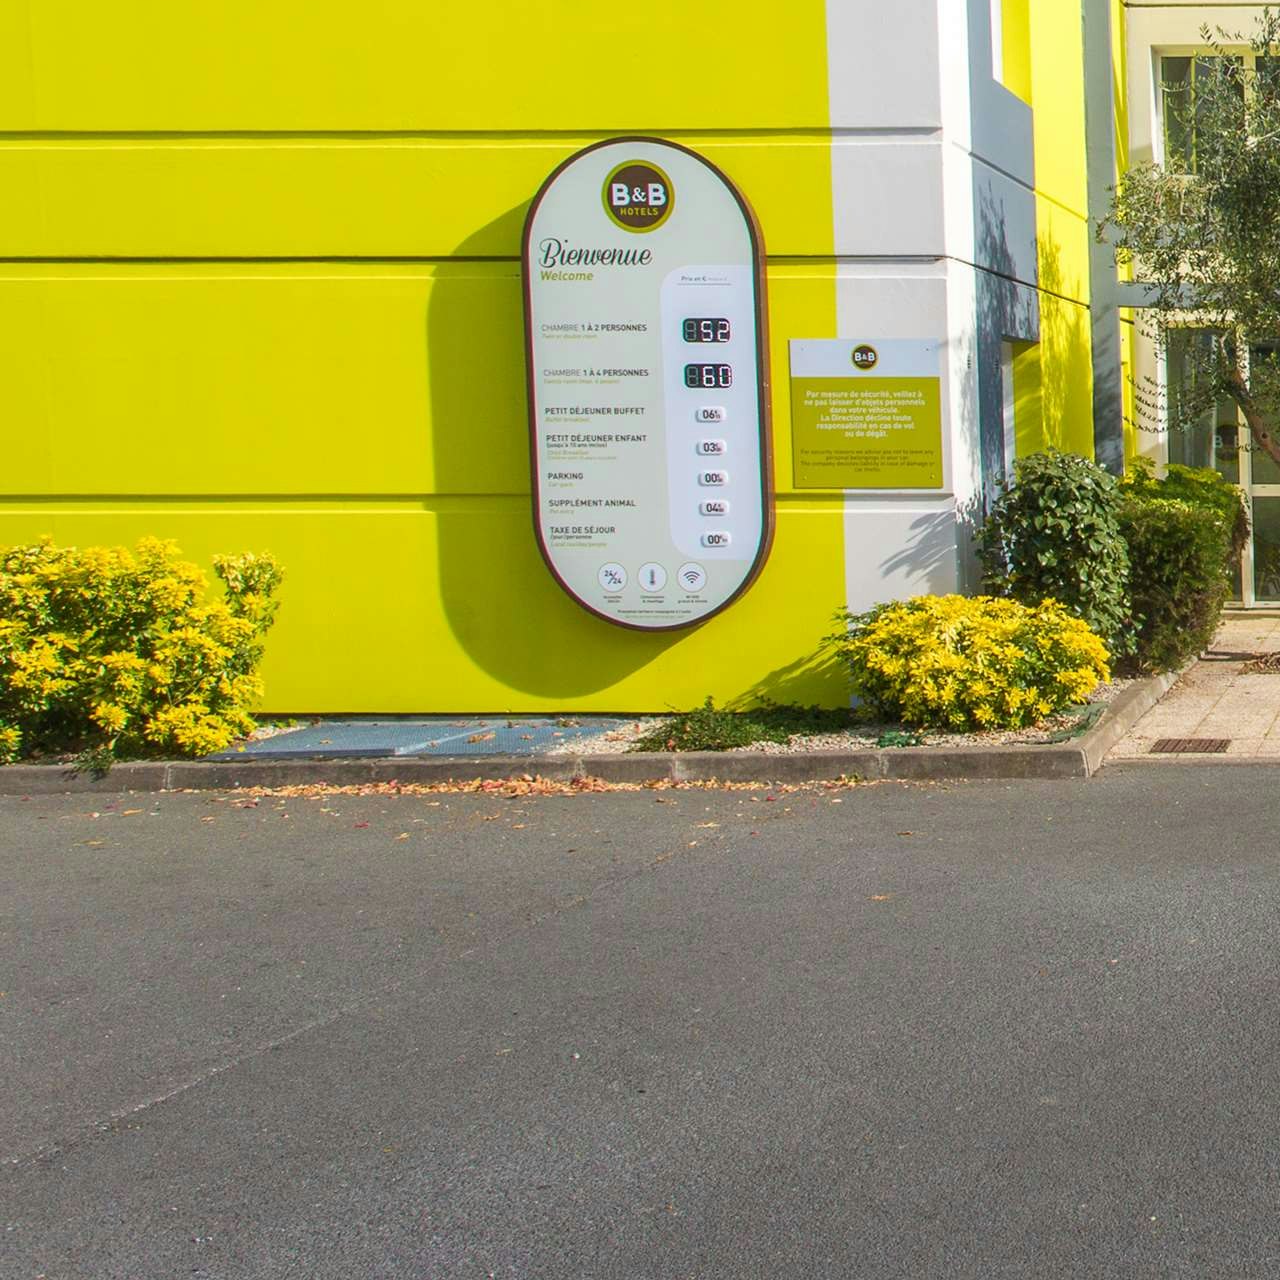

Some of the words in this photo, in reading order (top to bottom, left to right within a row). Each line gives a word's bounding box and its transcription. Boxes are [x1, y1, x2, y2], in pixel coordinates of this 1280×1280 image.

[611, 183, 667, 206] B&B
[620, 207, 659, 216] HOTELS
[539, 237, 653, 269] Bienvenue
[541, 270, 594, 281] Welcome
[541, 324, 578, 332] CHAMBRE
[581, 324, 586, 332] 1
[594, 324, 600, 332] 2
[601, 324, 648, 332] PERSONNES
[700, 320, 730, 342] 52
[543, 369, 581, 377] CHAMBRE
[583, 369, 588, 377] 1
[596, 369, 602, 377] 4
[603, 369, 649, 377] PERSONNES
[545, 407, 568, 415] PETIT
[569, 405, 612, 415] DÉJEUNER
[613, 407, 645, 415] BUFFET
[546, 434, 569, 442] PETIT
[571, 433, 613, 442] DÉJEUNER
[615, 434, 647, 442] ENFANT
[547, 472, 584, 480] PARKING
[548, 497, 602, 507] SUPPLÉMENT
[604, 499, 636, 507] ANIMAL
[550, 526, 569, 534] TAXE
[571, 526, 582, 534] DE
[584, 524, 616, 534] SÉJOUR
